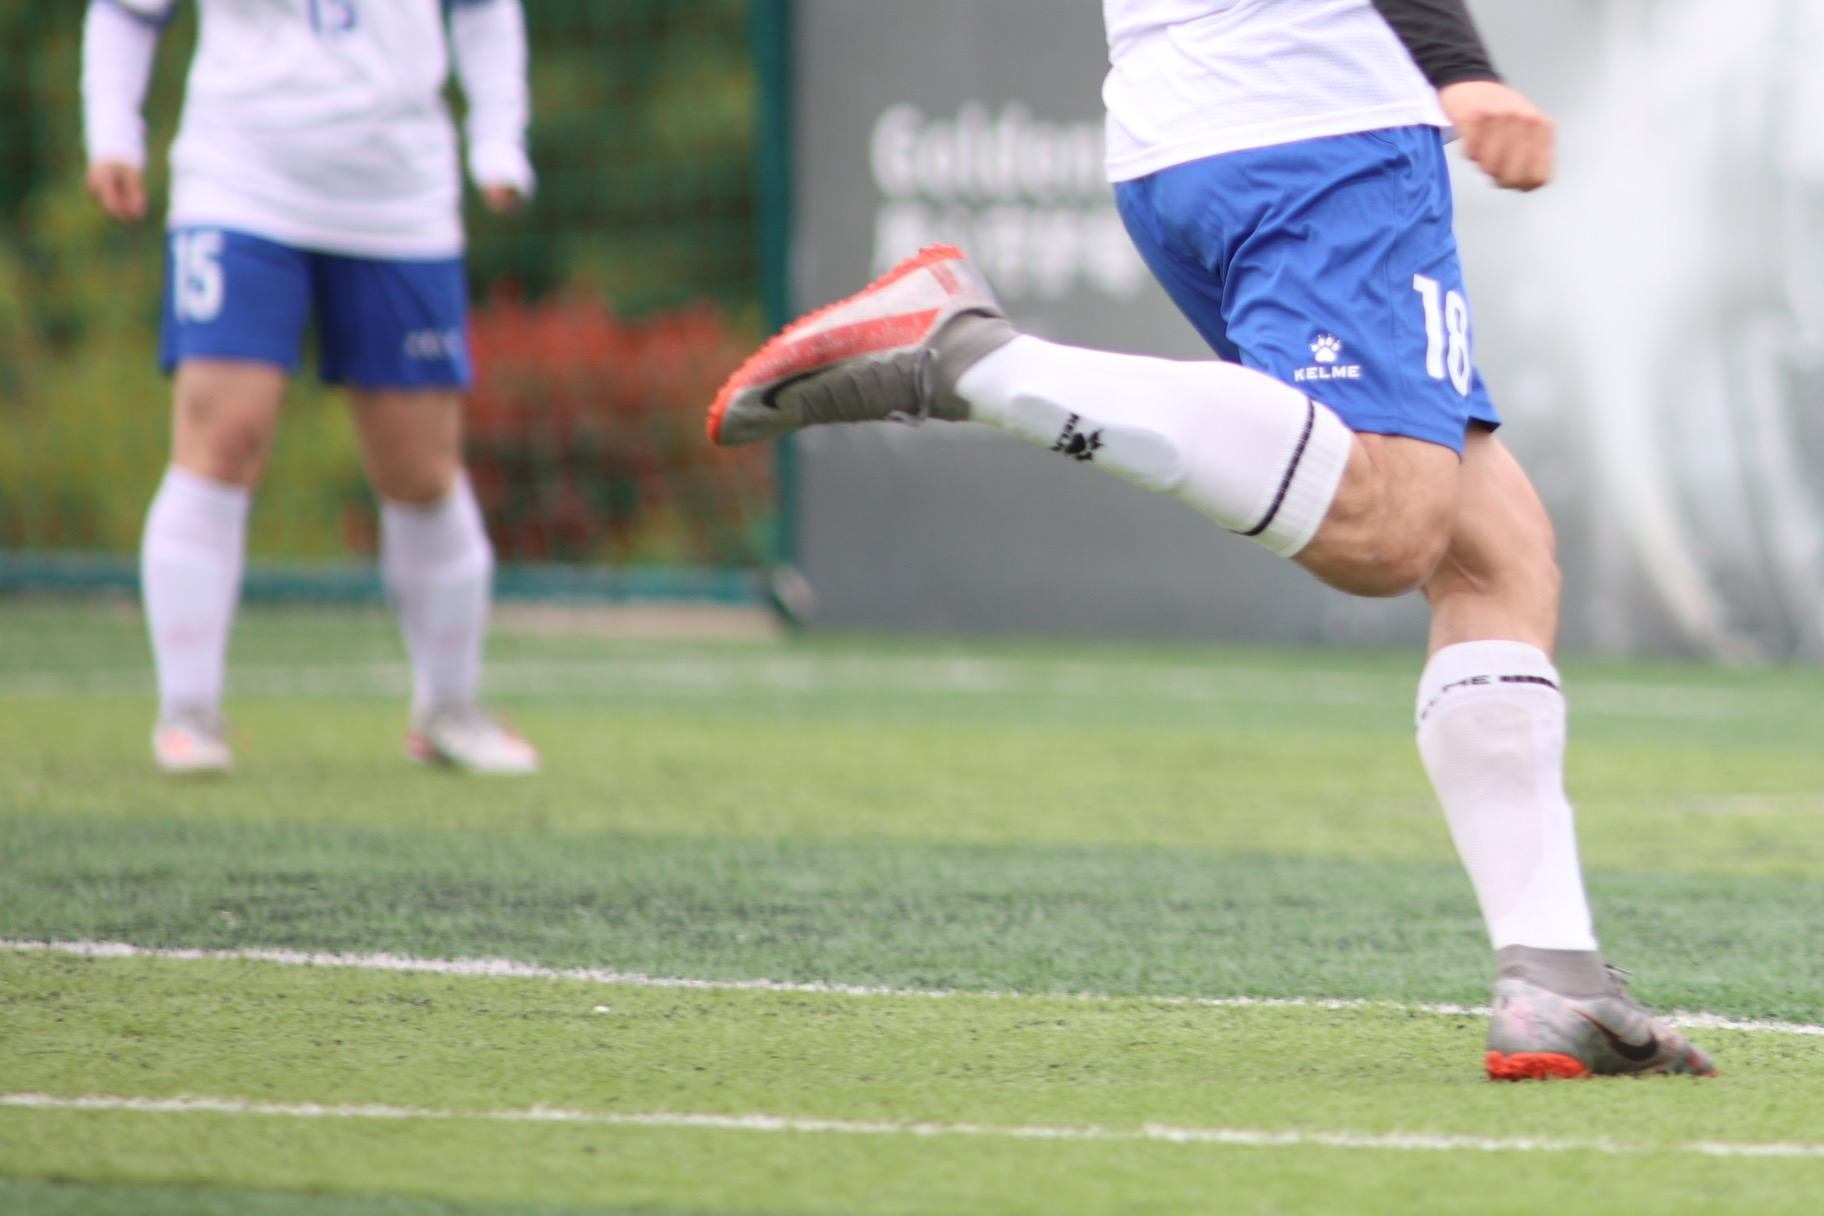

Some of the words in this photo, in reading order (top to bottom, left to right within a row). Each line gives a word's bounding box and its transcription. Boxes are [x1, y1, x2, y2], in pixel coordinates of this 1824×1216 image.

[170, 229, 225, 323] 15
[1294, 364, 1361, 382] KELME
[1412, 273, 1470, 397] 18
